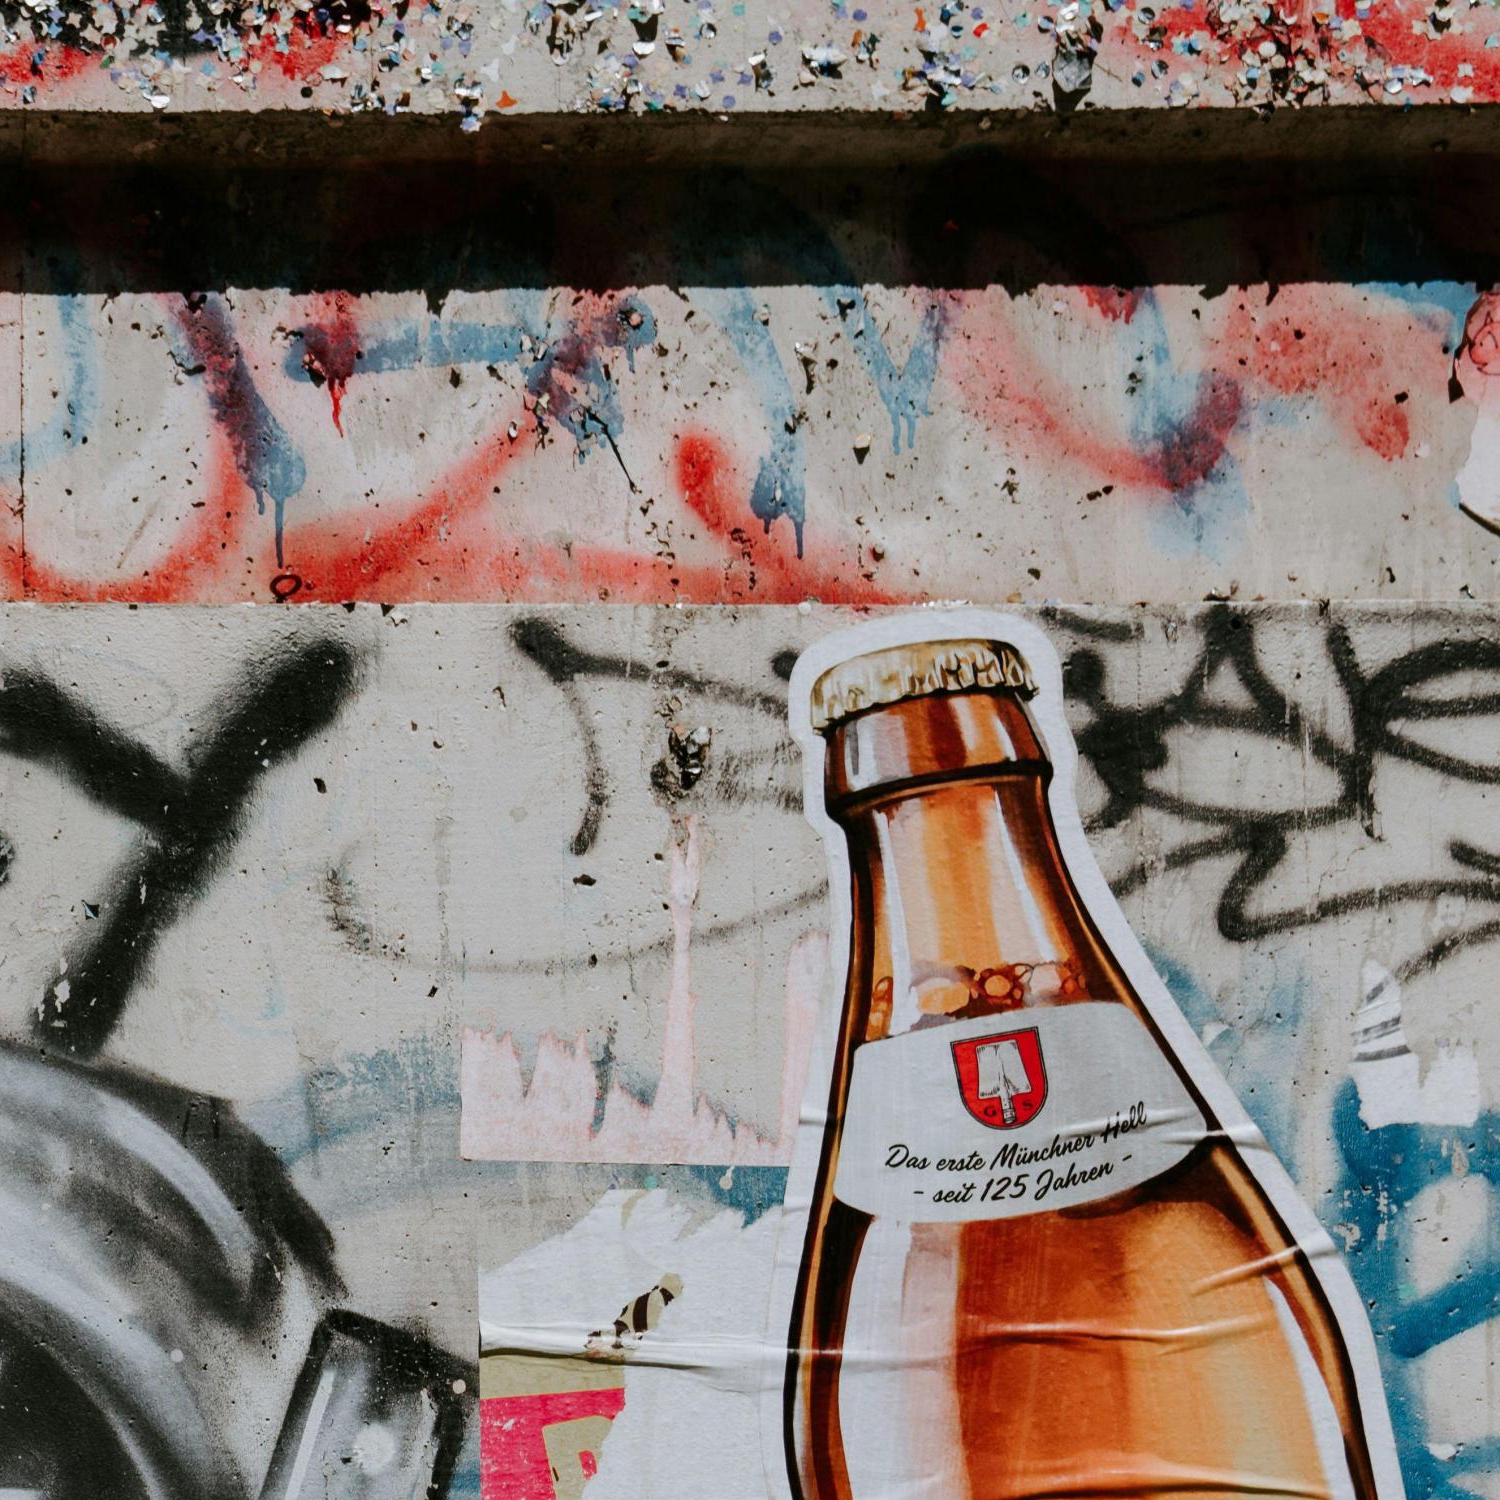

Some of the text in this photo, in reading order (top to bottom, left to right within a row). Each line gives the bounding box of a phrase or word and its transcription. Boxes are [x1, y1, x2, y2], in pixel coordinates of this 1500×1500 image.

[885, 1101, 1147, 1172] Das erste Münchner Hell
[932, 1162, 1114, 1203] seit 125 Jahren
